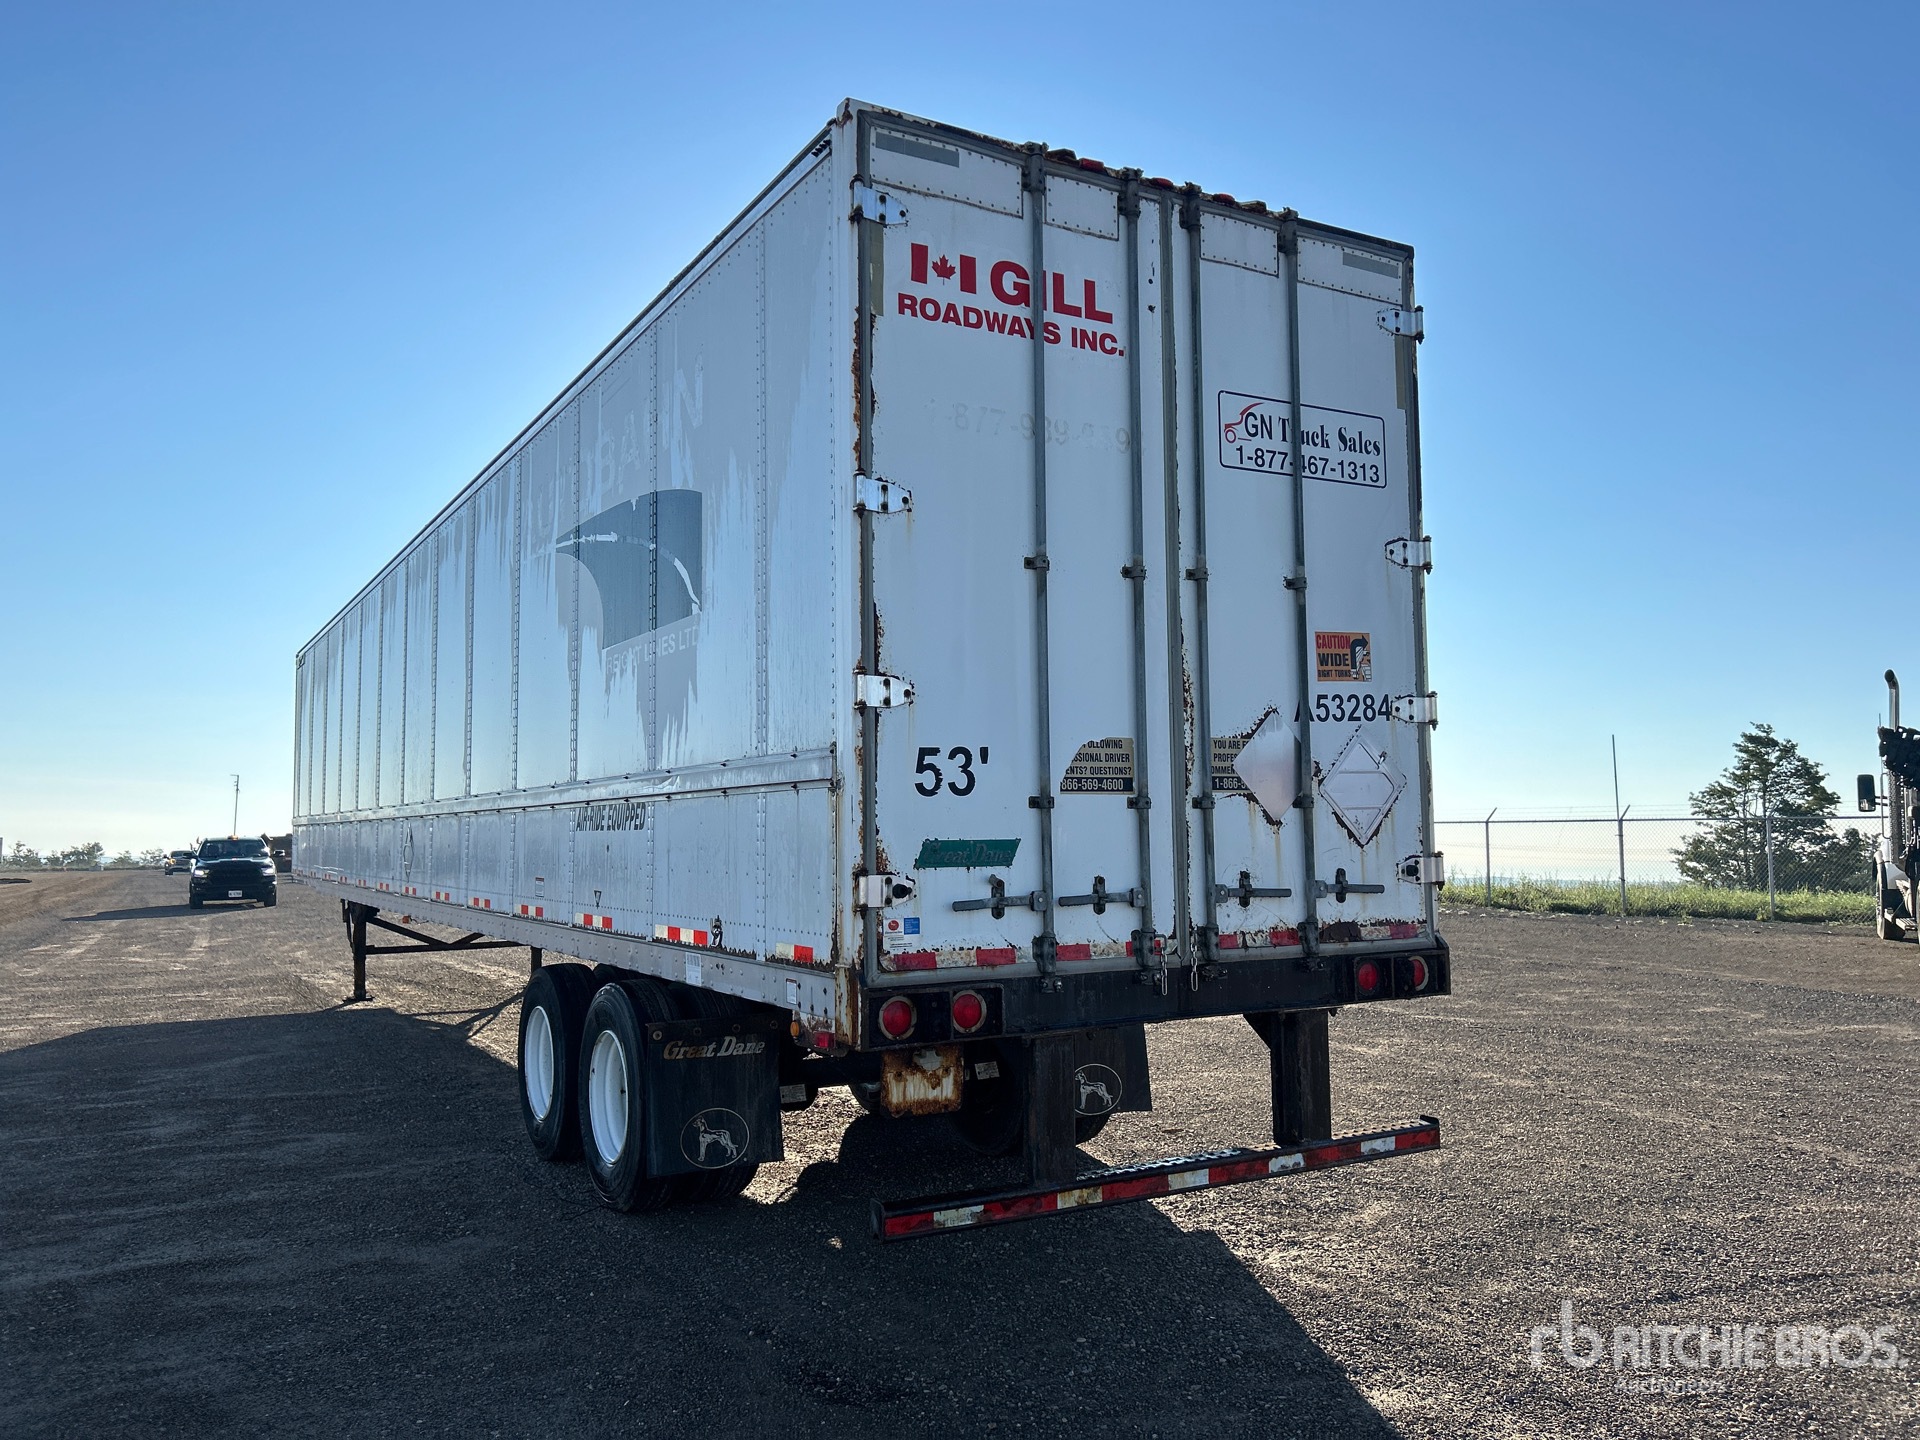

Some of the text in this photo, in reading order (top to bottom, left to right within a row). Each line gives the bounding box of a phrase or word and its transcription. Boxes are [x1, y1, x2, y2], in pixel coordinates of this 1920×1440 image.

[898, 293, 1125, 356] ROADWAYS INC.
[1244, 412, 1381, 457] GN Tuck Sales
[1316, 634, 1351, 650] CAUTION
[1318, 653, 1350, 667] WIDE
[1318, 669, 1352, 678] RIGHT TURNS
[1083, 740, 1123, 749] OLLOWING
[1213, 740, 1227, 750] YOU
[1228, 740, 1241, 750] ARE
[1104, 753, 1130, 763] DRIVER
[1089, 766, 1132, 776] QUESTIONS?
[1211, 765, 1237, 775] OMMEN
[1061, 778, 1124, 791] 866-569-4600
[606, 802, 647, 832] EQUIPPED
[663, 1035, 766, 1060] Great Dane
